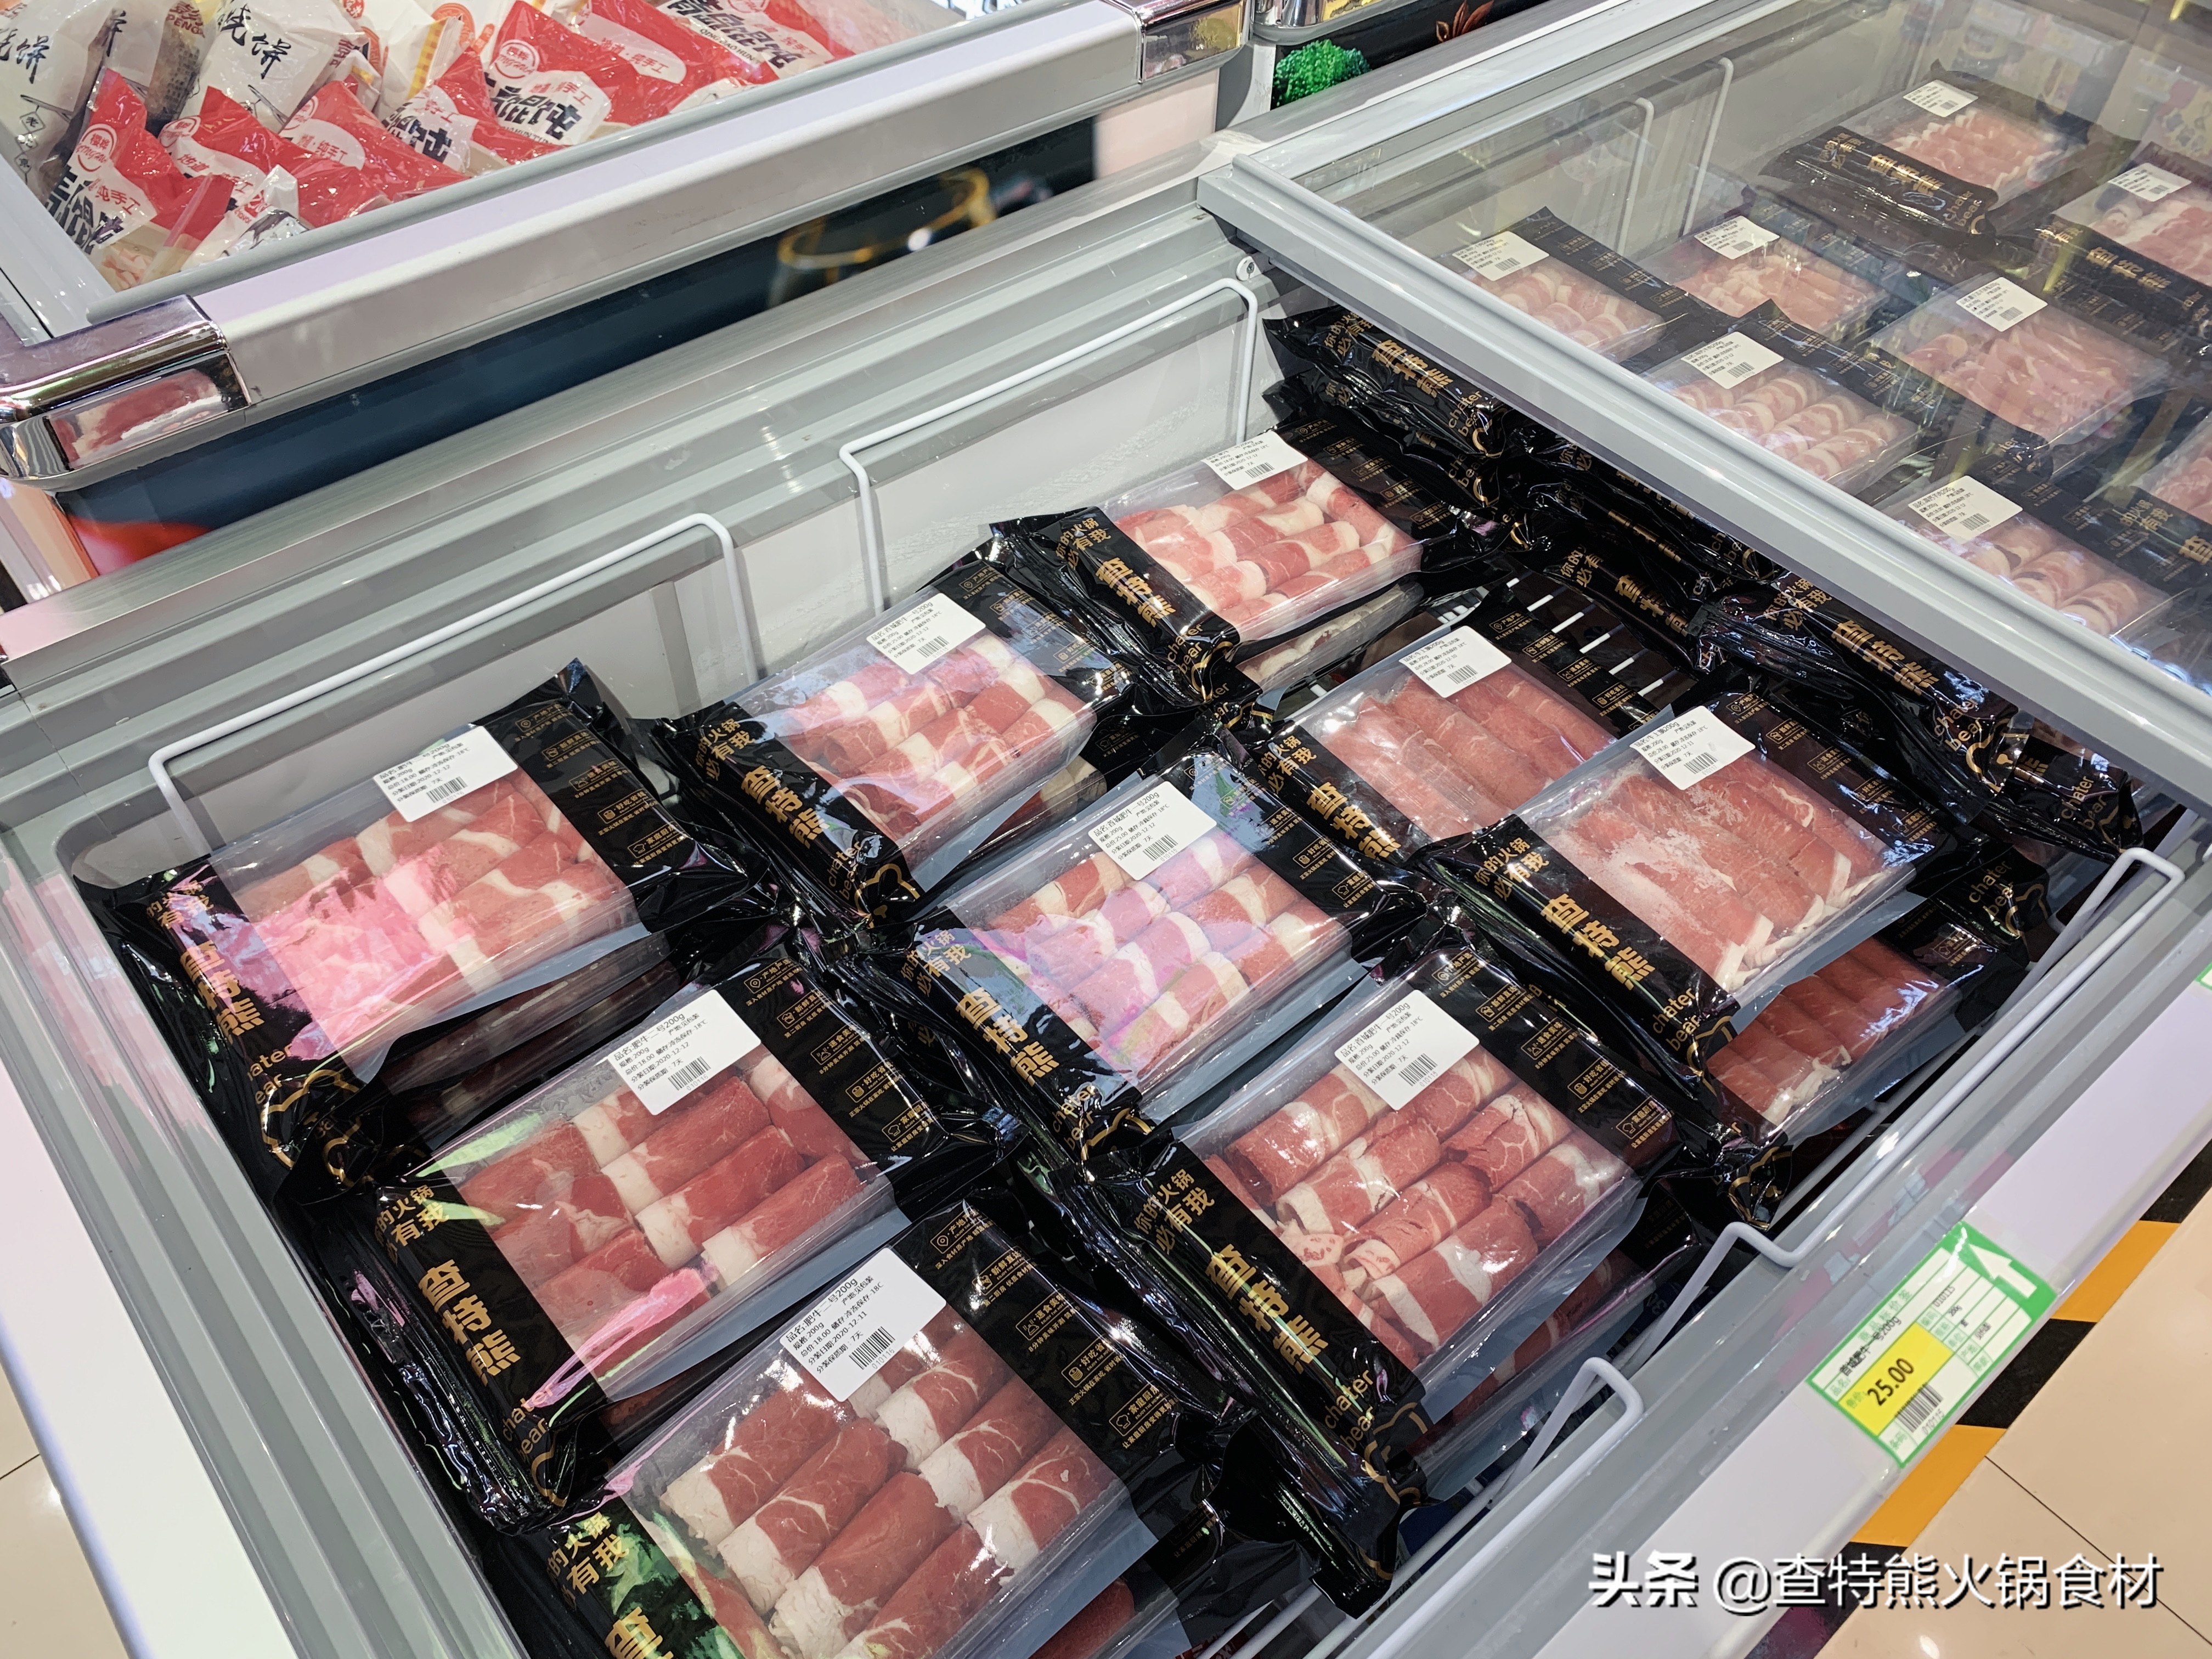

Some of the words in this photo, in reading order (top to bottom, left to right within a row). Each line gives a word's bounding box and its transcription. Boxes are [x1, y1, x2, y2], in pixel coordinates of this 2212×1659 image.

[631, 53, 669, 74] 纯手工
[94, 186, 140, 215] 纯手工
[1372, 339, 1453, 398] 查特熊
[1448, 390, 1483, 429] chater
[1055, 517, 1099, 558] 你的火锅
[1067, 529, 1111, 569] 必有我
[1096, 557, 1176, 628] 查特熊
[1167, 623, 1204, 663] chater
[1178, 642, 1203, 675] bear
[1831, 619, 1940, 696] 查特熊
[1933, 697, 1979, 737] chater
[1945, 719, 1983, 752] bear
[695, 718, 741, 768] 你的火锅
[706, 729, 755, 781] 必有我
[1265, 747, 1317, 794] 必有我
[742, 765, 831, 849] 查特熊
[2061, 775, 2095, 820] chater
[2078, 795, 2108, 832] bear
[1098, 825, 1123, 843] 规格:200g
[1104, 831, 1129, 848] 总价:25.00
[1110, 822, 1156, 854] 分装日期:2020-12-12
[1306, 781, 1402, 861] 查特熊
[829, 841, 862, 887] chater
[1160, 848, 1178, 861] 010115
[1474, 837, 1531, 887] 你的火锅
[1493, 851, 1549, 902] 必有我
[1968, 861, 2013, 904] chater
[900, 930, 955, 982] 你的火锅
[1540, 893, 1656, 991] 查特熊
[917, 944, 972, 997] 必有我
[1652, 987, 1696, 1035] chater
[613, 1012, 686, 1062] 品名:肥牛二号200g
[955, 987, 1060, 1087] 查特熊
[1347, 1042, 1373, 1064] 规格:200g
[1666, 1014, 1702, 1052] bear
[247, 1042, 294, 1081] ater
[618, 1046, 650, 1069] 规格:200g
[624, 1053, 656, 1075] 总价:18.00
[630, 1041, 691, 1082] 分装日期:2020-12-12
[1362, 1039, 1410, 1077] 分装日期:2020-12-12
[255, 1074, 283, 1104] ear
[686, 1074, 709, 1091] 010116
[1419, 1070, 1438, 1087] 010115
[1052, 1084, 1096, 1133] chater
[1064, 1110, 1093, 1150] bear
[1133, 1169, 1195, 1235] 你的火锅
[1155, 1186, 1215, 1255] 必有我
[989, 1247, 1022, 1277] 新鲜直达
[785, 1278, 859, 1342] 品名:肥牛二号200g
[840, 1275, 874, 1305] 产地:见包装
[1034, 1291, 1065, 1321] 速食美味
[1204, 1243, 1329, 1374] 查特熊
[1931, 1284, 1956, 1308] 010115
[418, 1259, 521, 1387] 查特熊
[792, 1321, 825, 1350] 规格:200g
[799, 1328, 832, 1357] 总价:18.00
[807, 1310, 868, 1365] 分装日期:2020-12-11
[871, 1347, 895, 1369] 010116
[1068, 1369, 1106, 1406] 正宗火锅在家吃
[1127, 1384, 1160, 1415] 家庭厨房
[1324, 1370, 1374, 1430] chater
[1865, 1355, 1917, 1407] 25.00
[502, 1384, 554, 1442] chater
[1340, 1406, 1374, 1452] bear
[1920, 1407, 1946, 1435] 010115
